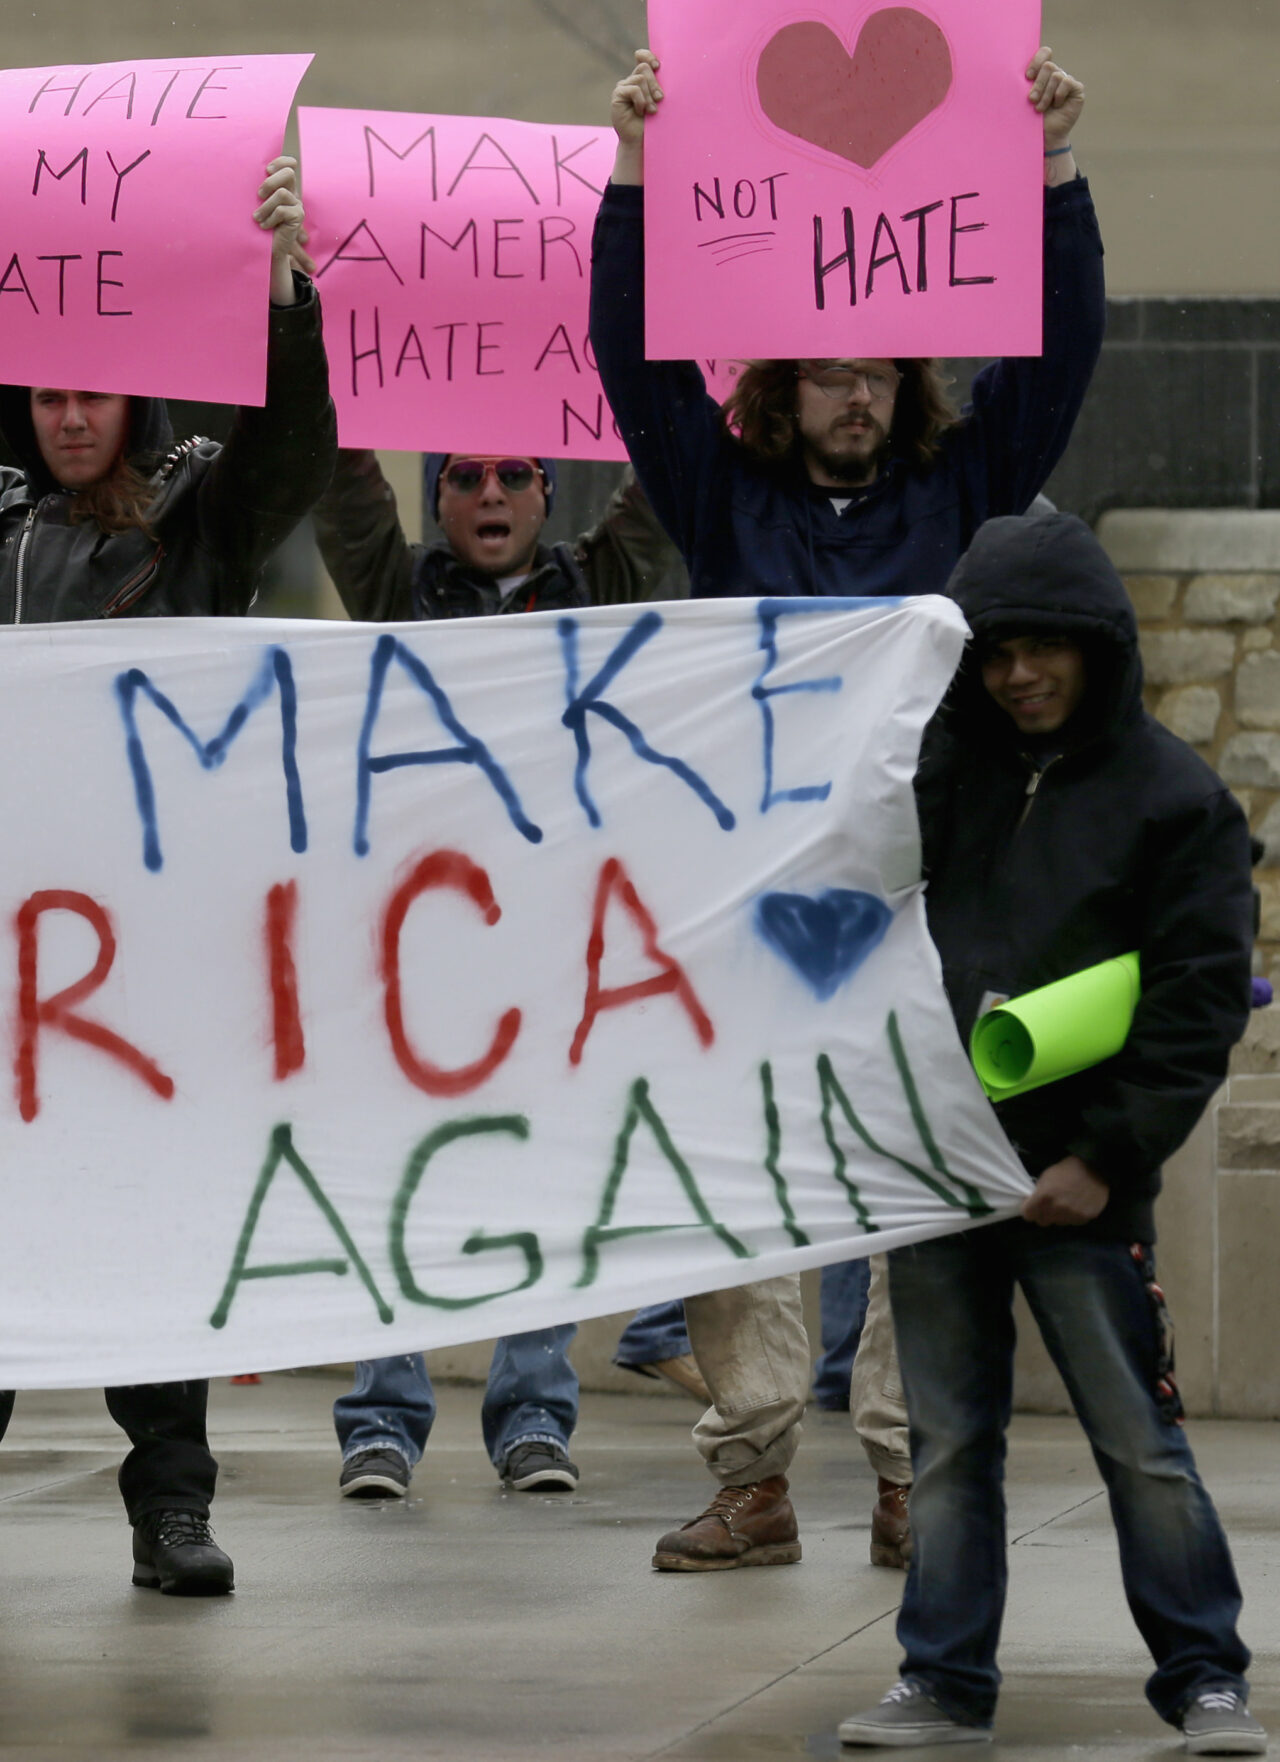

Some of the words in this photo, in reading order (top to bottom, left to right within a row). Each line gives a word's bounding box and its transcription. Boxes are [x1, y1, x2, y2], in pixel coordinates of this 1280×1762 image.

[28, 66, 243, 126] HATE
[32, 147, 151, 223] MY
[693, 172, 789, 221] NOT
[813, 192, 997, 310] HATE
[351, 306, 505, 397] HATE
[113, 596, 904, 872] MAKE
[209, 1009, 999, 1331] AGAIN
